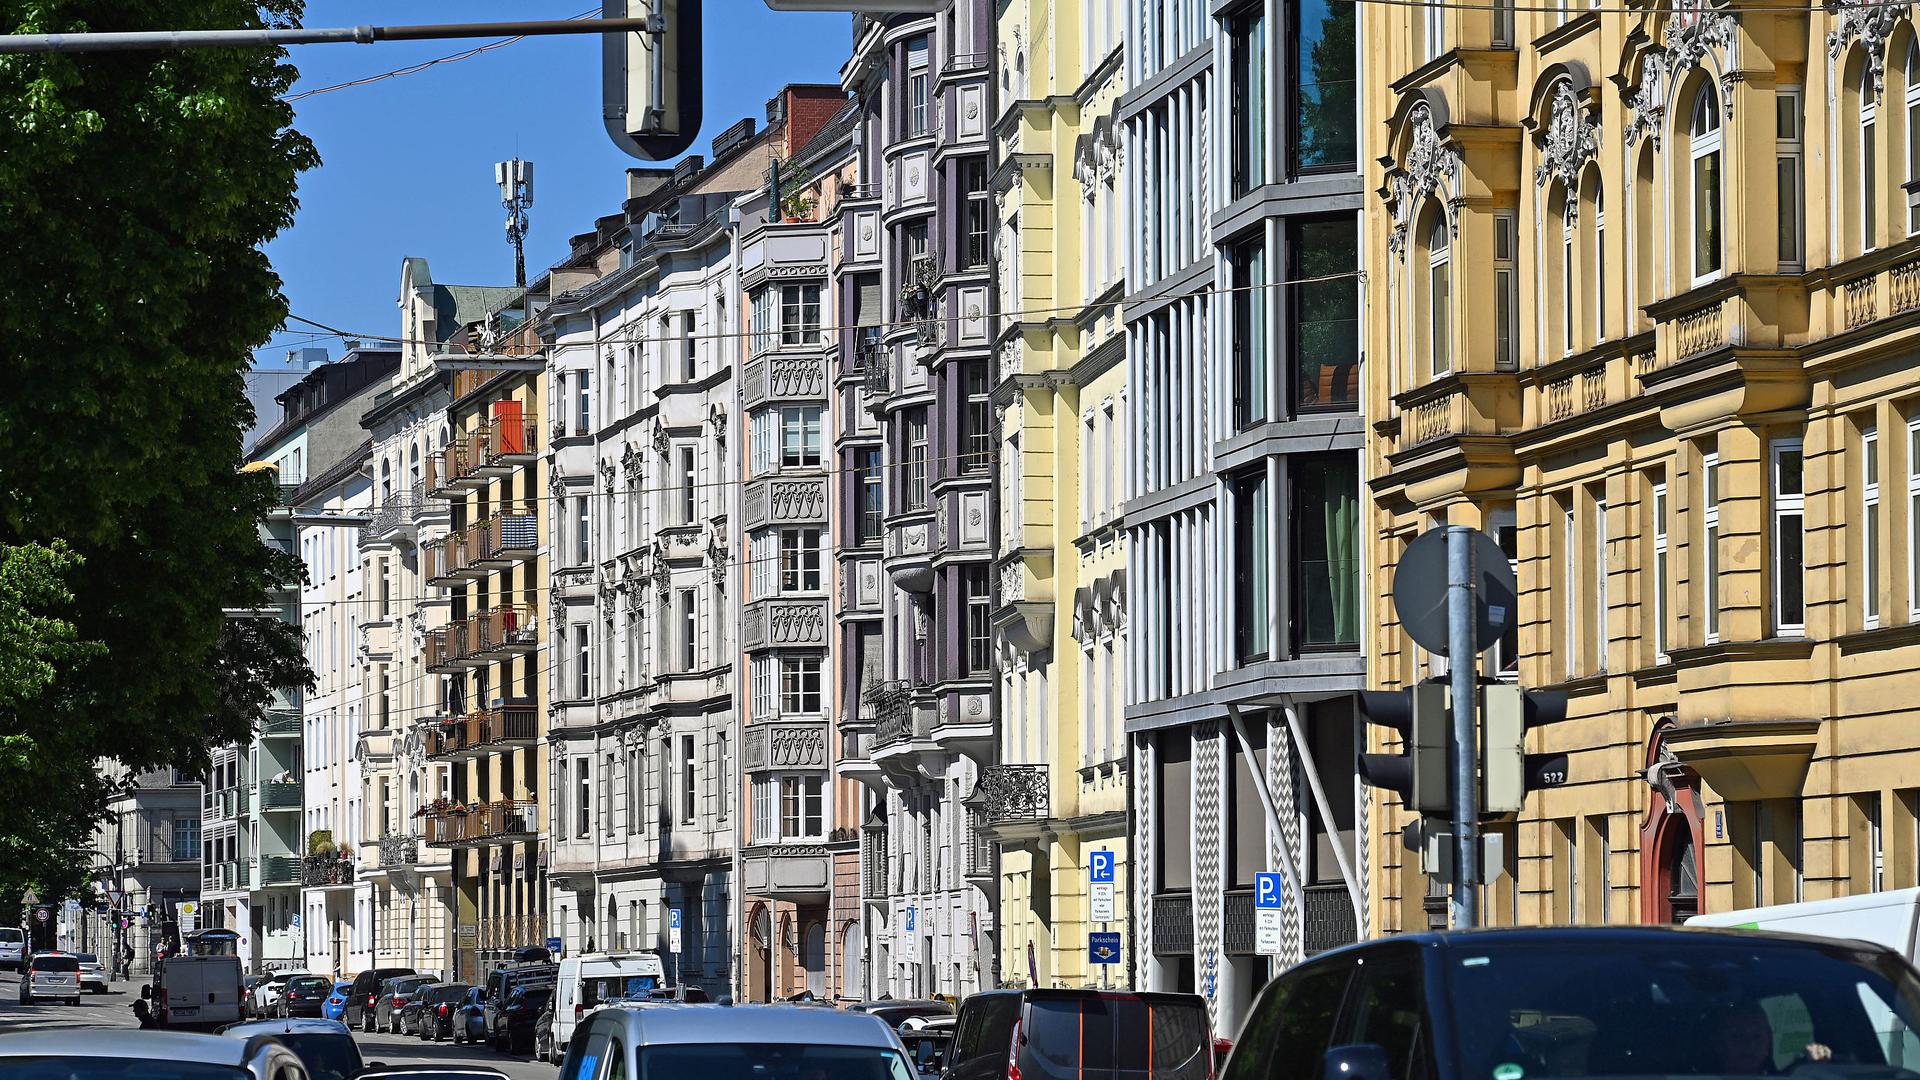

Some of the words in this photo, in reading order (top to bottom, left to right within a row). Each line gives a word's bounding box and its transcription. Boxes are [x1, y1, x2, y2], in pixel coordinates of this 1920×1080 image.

[1544, 771, 1563, 783] 522
[1093, 855, 1107, 878] P
[1260, 877, 1273, 904] P
[671, 912, 677, 927] P
[907, 910, 913, 929] P
